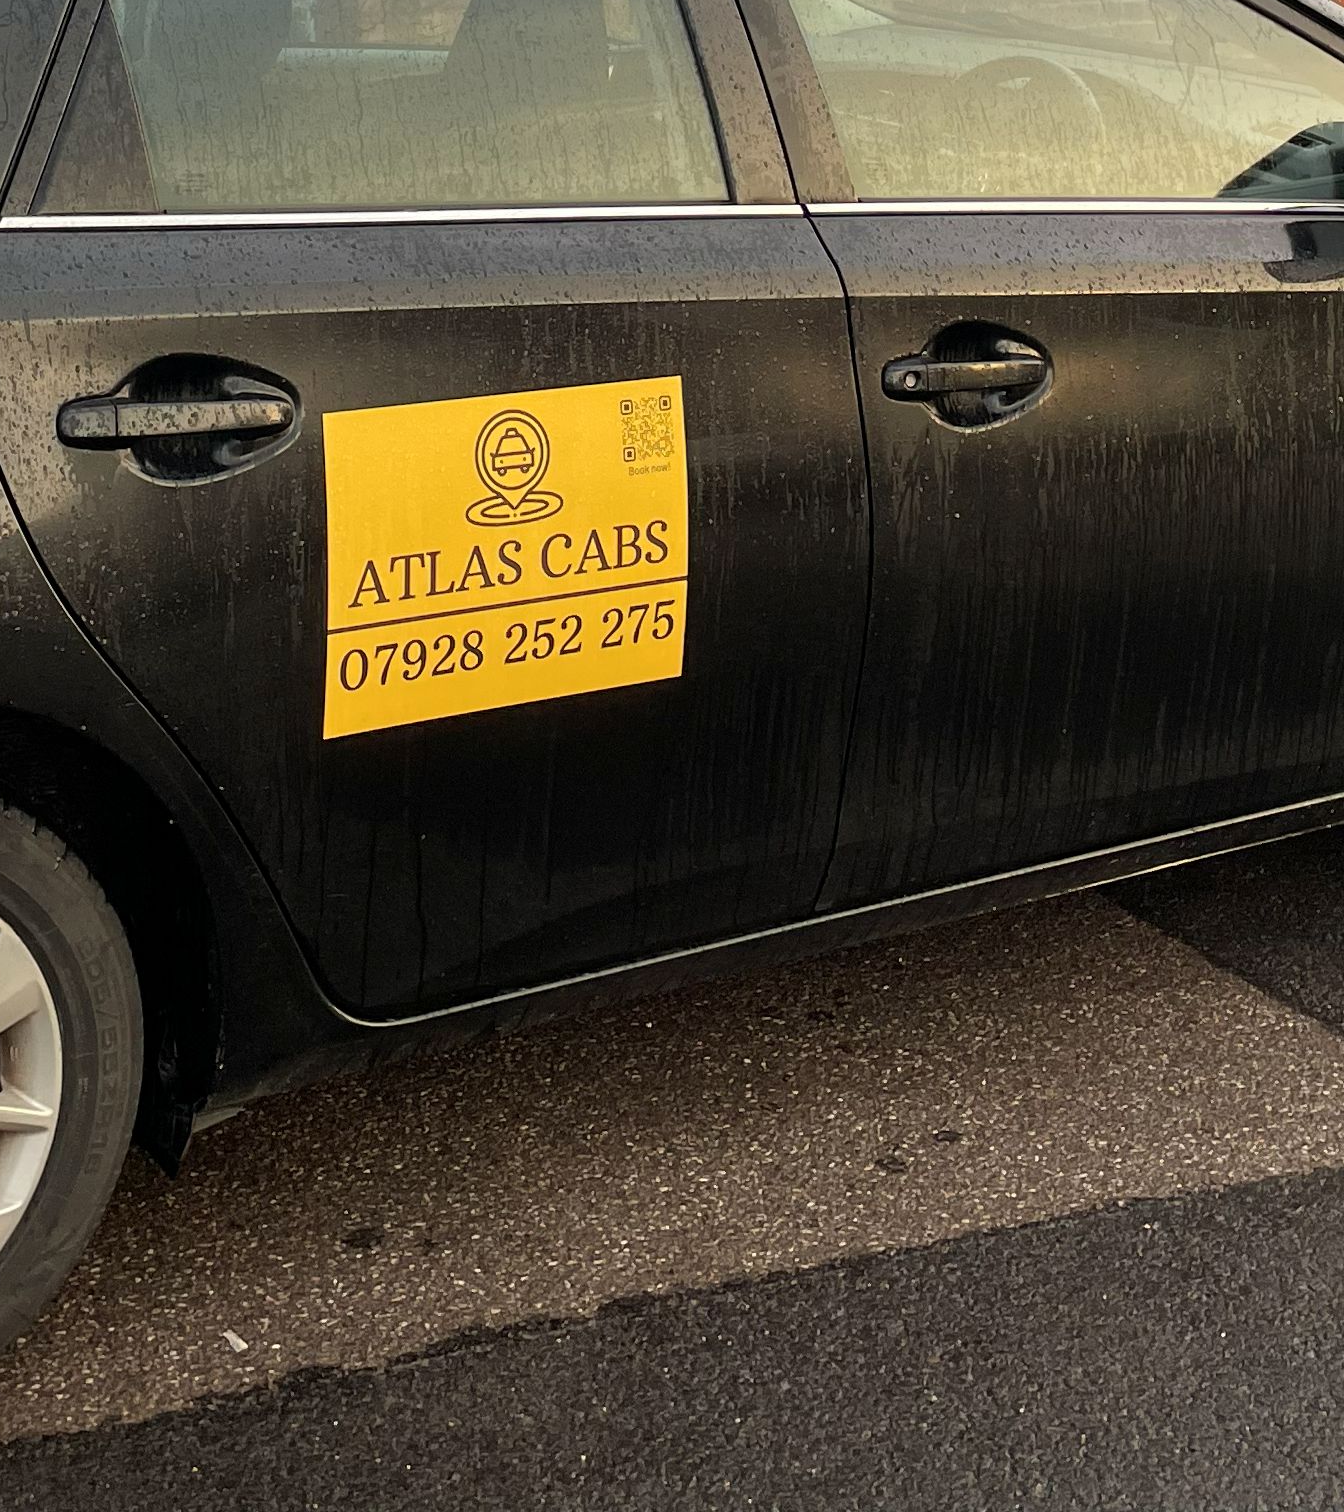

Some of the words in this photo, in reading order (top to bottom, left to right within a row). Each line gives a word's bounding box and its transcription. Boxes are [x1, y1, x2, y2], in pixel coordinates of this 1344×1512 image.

[629, 466, 650, 476] Book
[651, 461, 672, 473] now!
[348, 540, 523, 608] ATLAS
[540, 520, 669, 578] CABS
[340, 631, 484, 692] 07928
[504, 615, 583, 665] 252
[601, 600, 676, 649] 275
